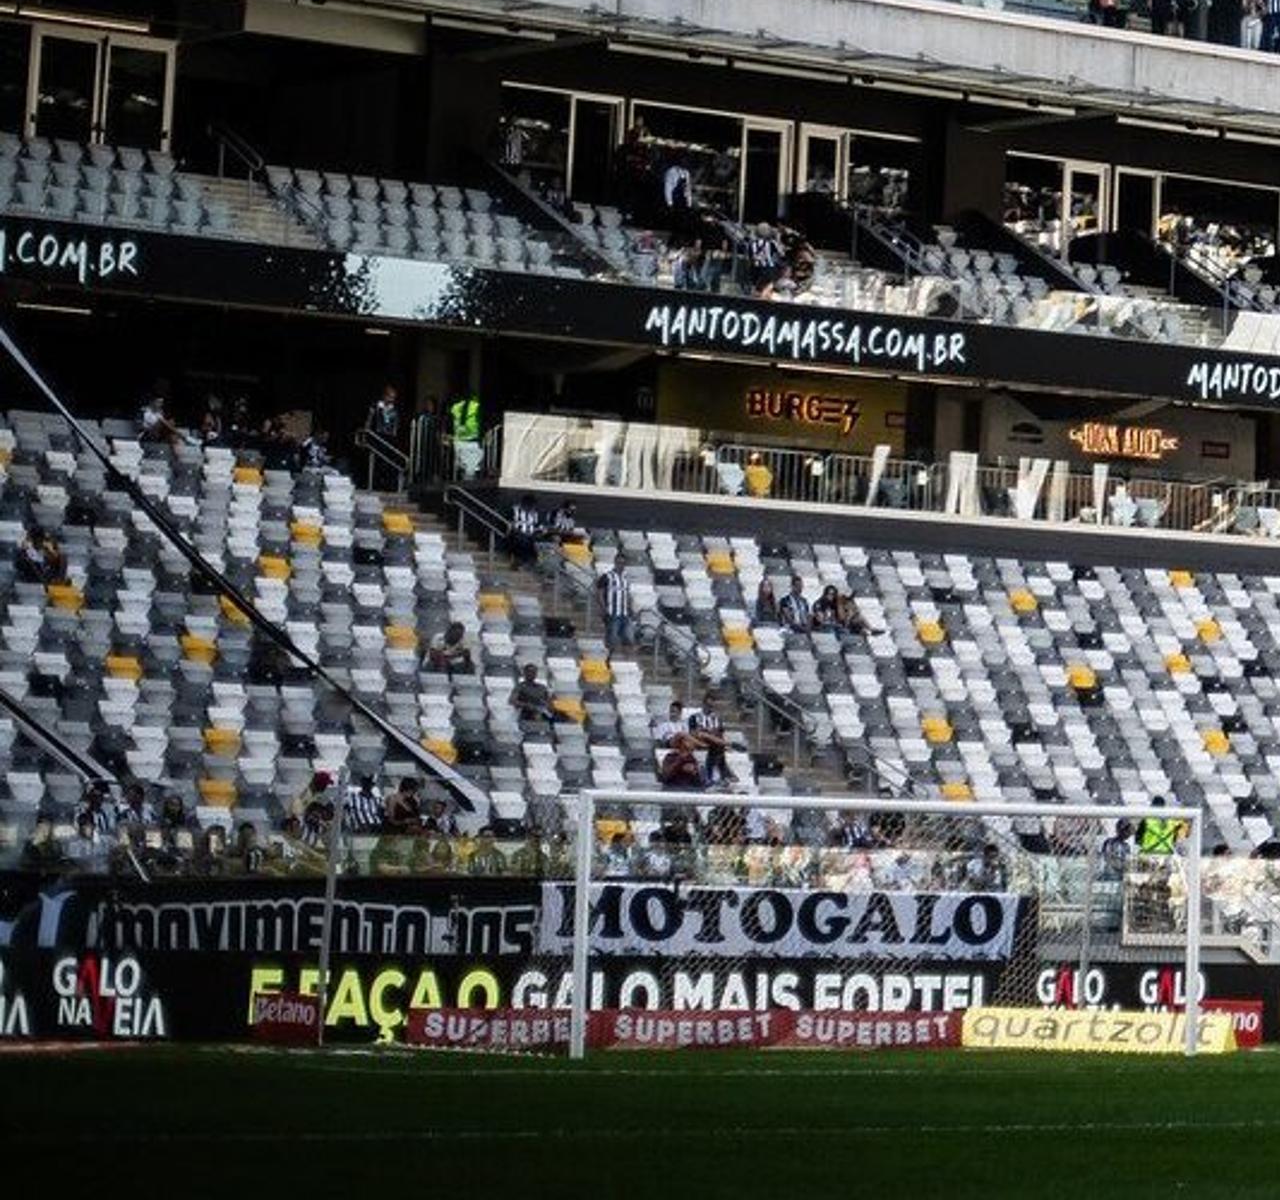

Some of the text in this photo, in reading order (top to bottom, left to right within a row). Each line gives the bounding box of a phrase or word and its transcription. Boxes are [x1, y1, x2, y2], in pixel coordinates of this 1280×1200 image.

[645, 305, 965, 371] MANTODAMASSA.COM.BR
[557, 884, 1003, 944] MOTOGALO
[53, 956, 141, 996] GALO
[674, 972, 801, 1011] MAIS
[58, 997, 92, 1025] NA
[614, 1013, 772, 1046] SUPERBET
[796, 1013, 949, 1046] SUPERBET
[972, 1013, 1216, 1047] quartzolit
